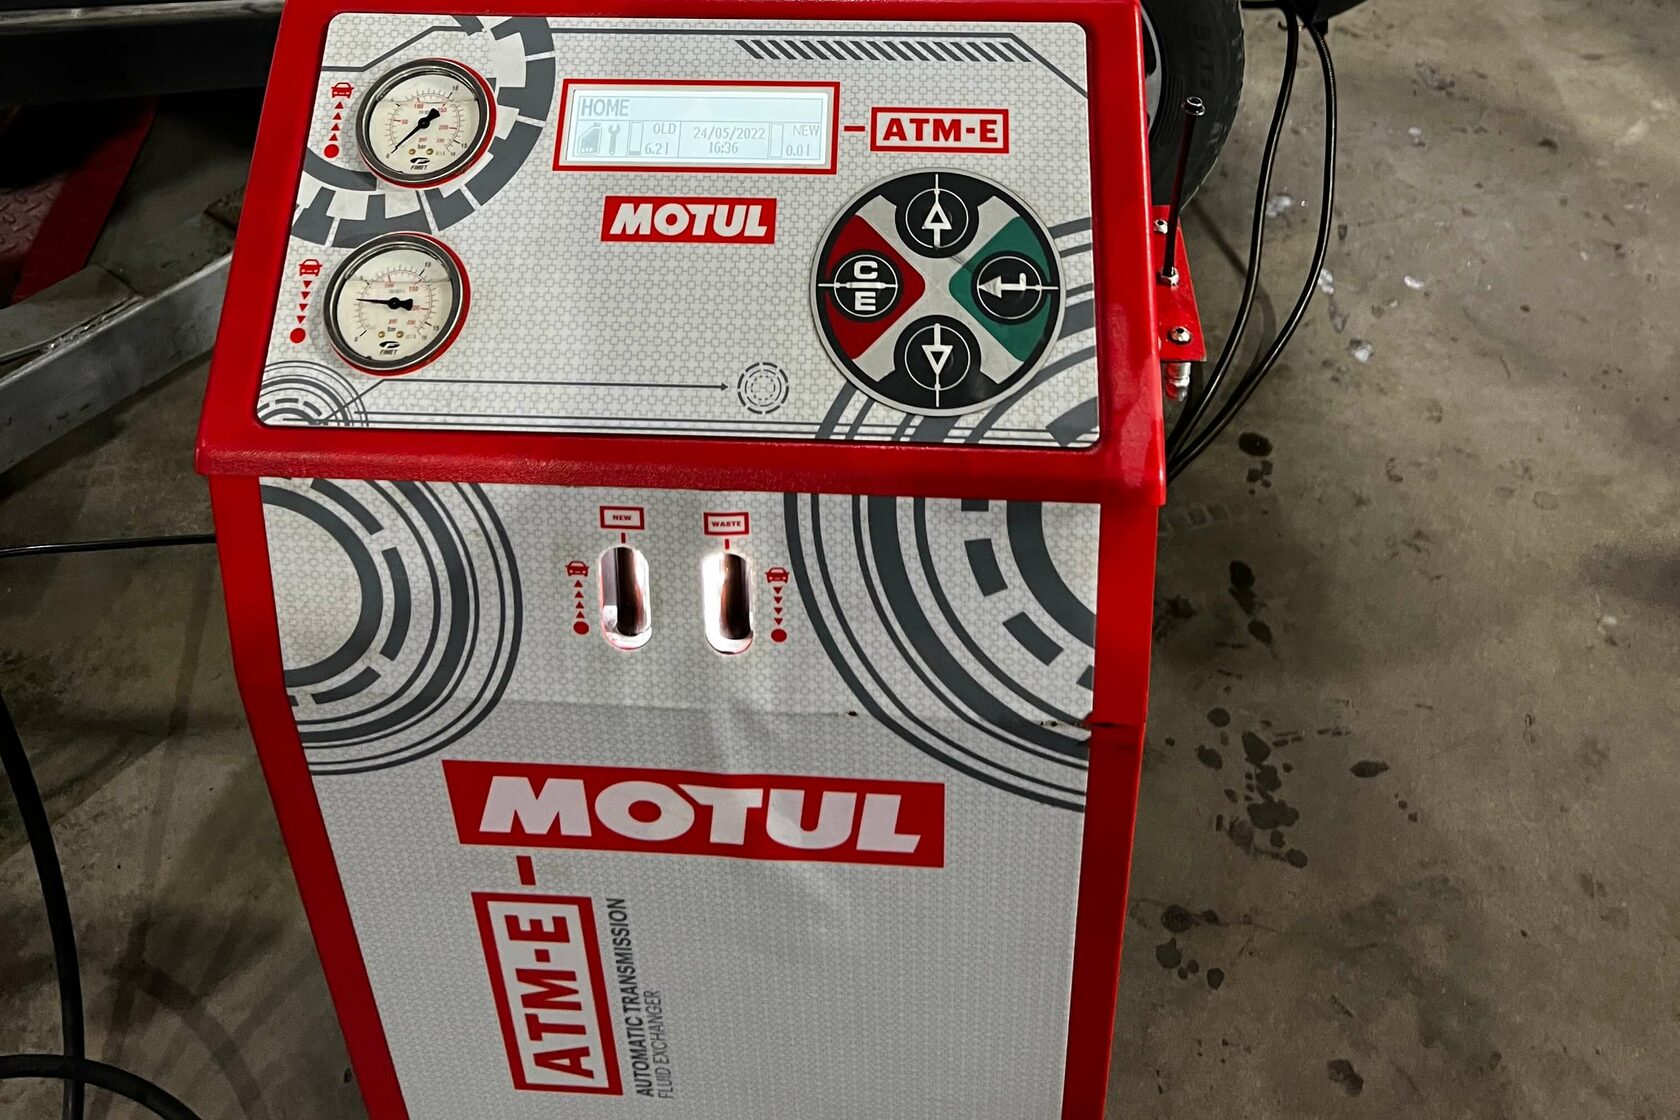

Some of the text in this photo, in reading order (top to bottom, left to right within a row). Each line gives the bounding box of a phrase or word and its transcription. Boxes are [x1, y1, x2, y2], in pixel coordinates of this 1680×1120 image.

[580, 98, 630, 117] HOME
[653, 123, 677, 135] OLD
[693, 126, 766, 141] 24/05/2022
[792, 125, 821, 137] NEW
[883, 118, 998, 143] ATM-E
[708, 142, 739, 154] 16:36
[609, 202, 768, 238] MOTUL
[853, 260, 879, 280] C
[854, 291, 877, 311] E
[479, 776, 921, 853] MOTUL
[504, 913, 595, 1080] ATM-E
[606, 897, 655, 1098] AUTOMATIC TRANSMISSION
[643, 990, 675, 1099] FLUID EXCHANGER
